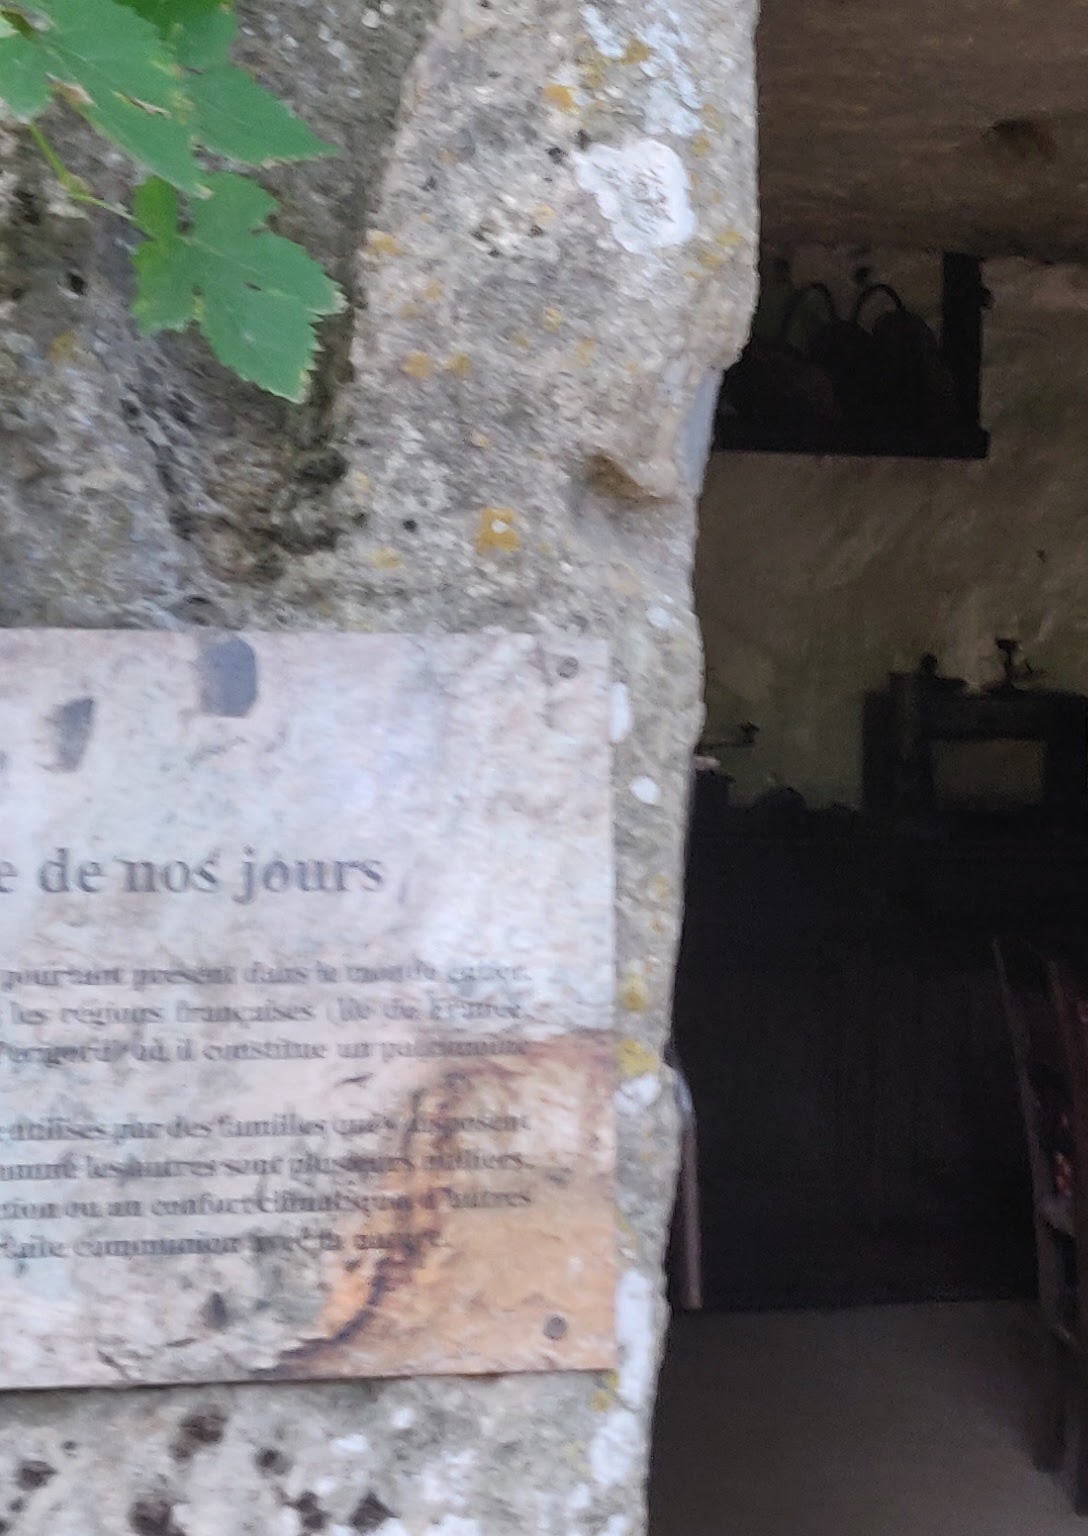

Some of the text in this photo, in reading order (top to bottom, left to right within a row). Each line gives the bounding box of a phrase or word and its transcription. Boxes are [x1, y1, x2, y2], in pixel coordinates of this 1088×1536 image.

[37, 847, 105, 893] de
[112, 850, 221, 893] nos
[232, 845, 384, 904] jours
[11, 1001, 48, 1025] les
[175, 998, 313, 1027] françaises
[167, 1114, 212, 1138] des
